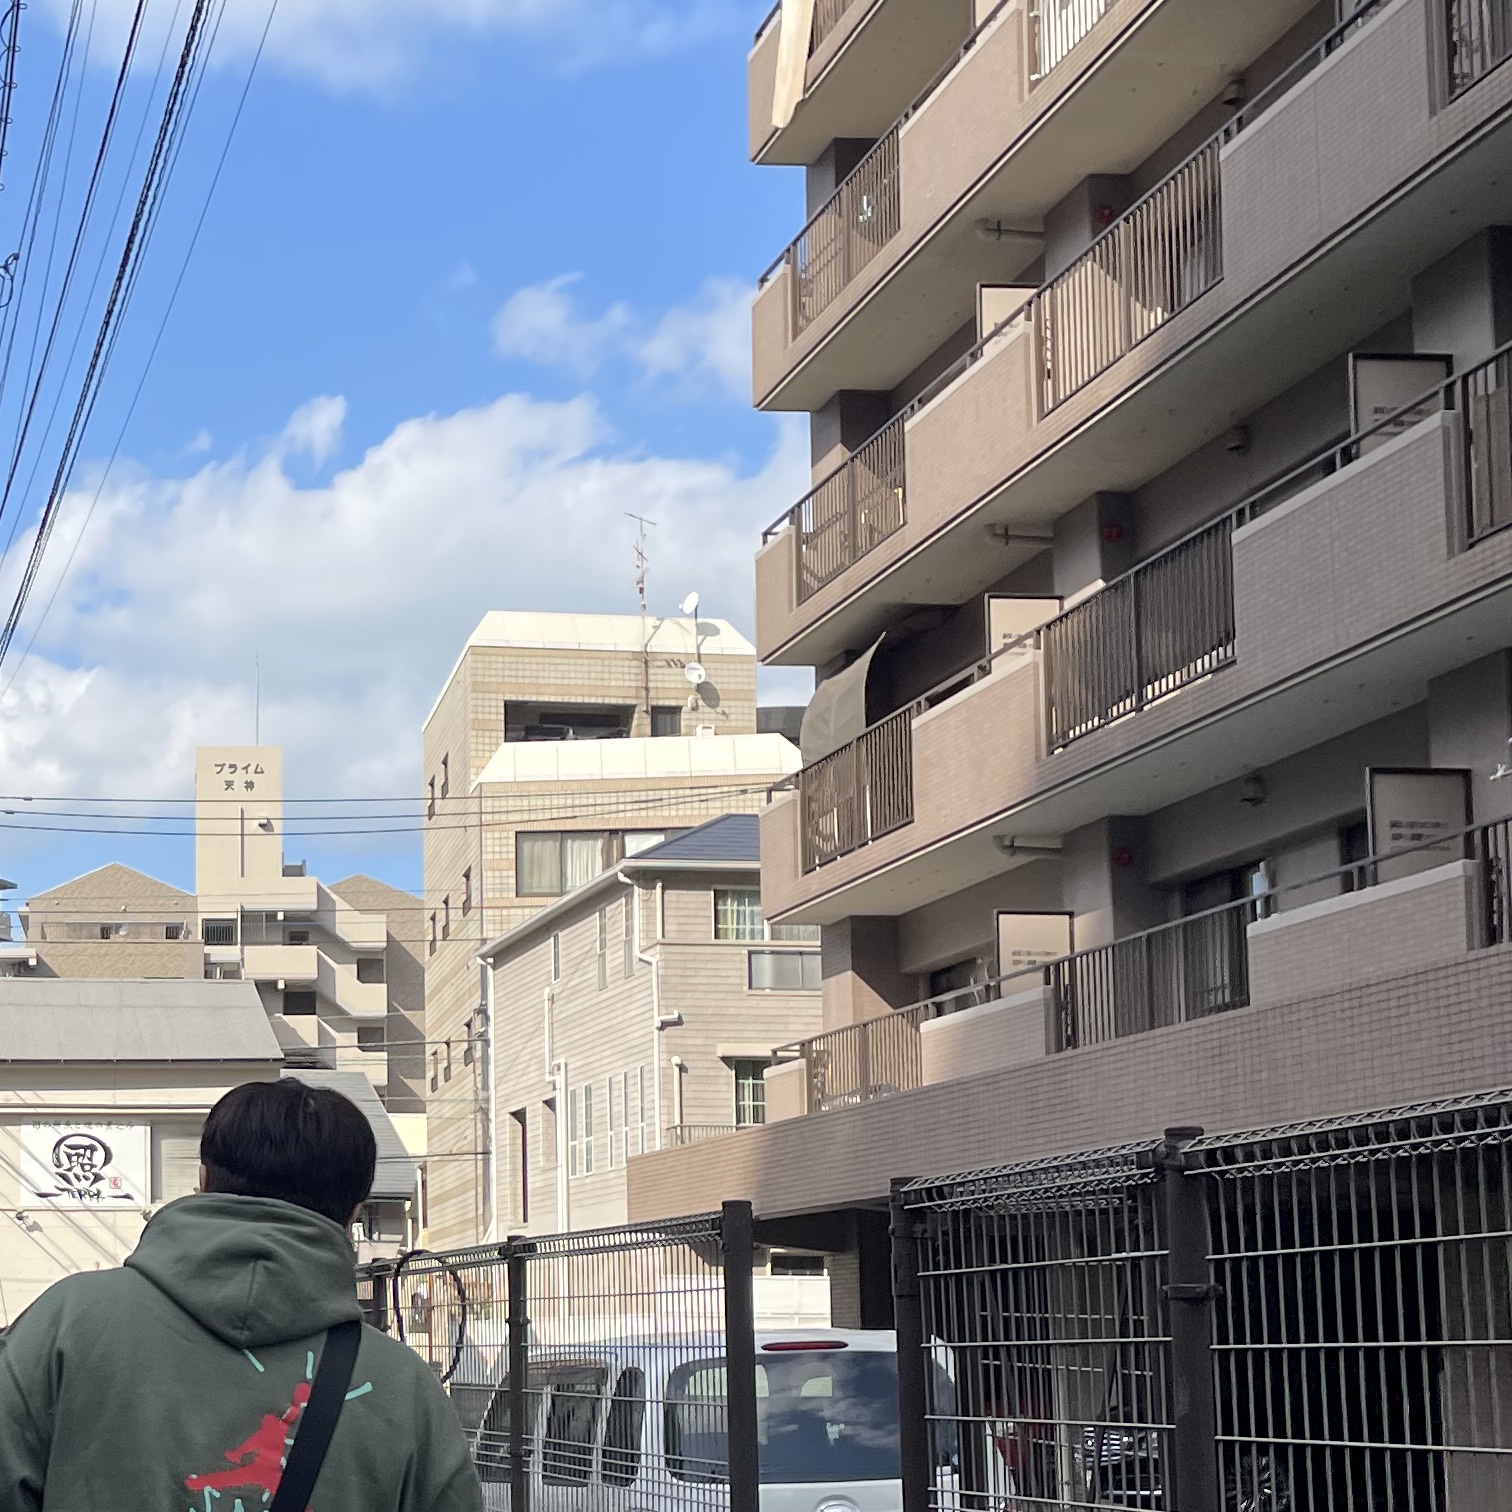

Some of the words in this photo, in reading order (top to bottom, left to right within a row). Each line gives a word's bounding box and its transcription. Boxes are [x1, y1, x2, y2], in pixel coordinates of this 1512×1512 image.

[214, 762, 265, 775] プライム
[223, 779, 256, 793] 天神
